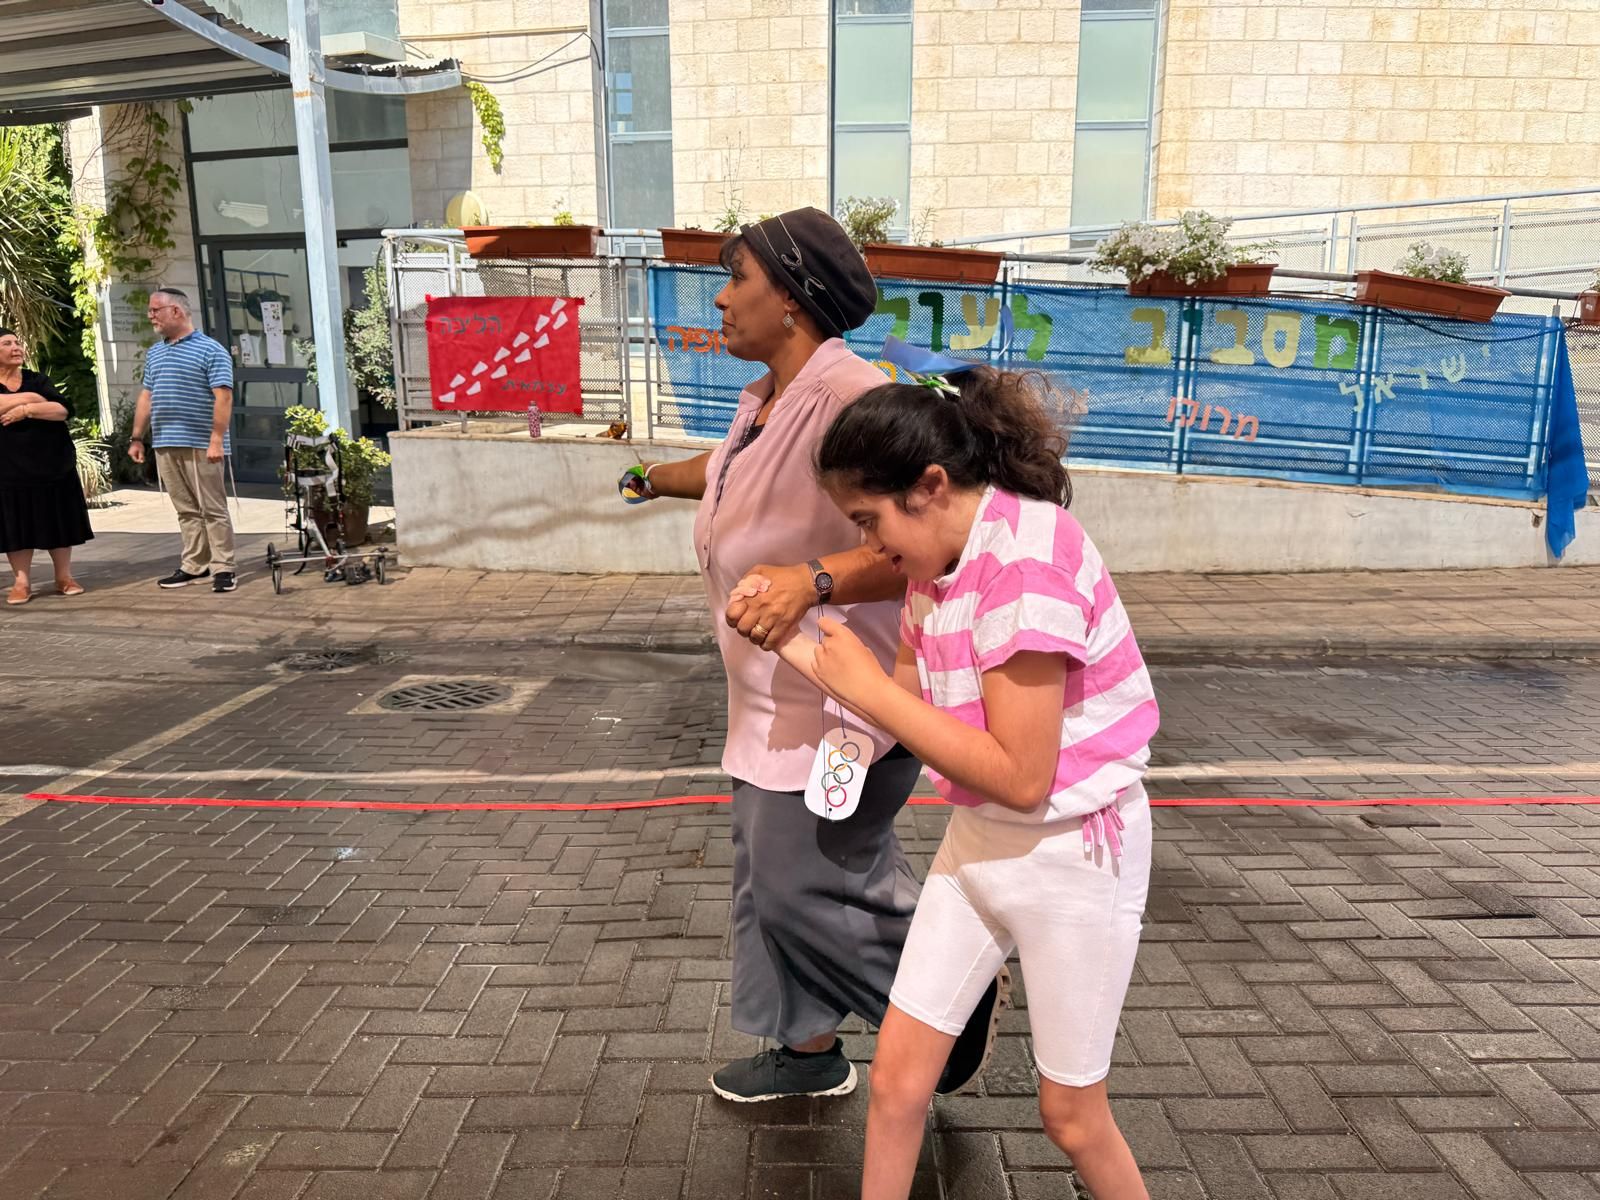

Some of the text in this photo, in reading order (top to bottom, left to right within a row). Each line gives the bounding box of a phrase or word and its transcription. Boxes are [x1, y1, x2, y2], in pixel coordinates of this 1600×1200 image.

[665, 325, 730, 355] ופה
[876, 287, 1360, 369] מסביב לעול
[1339, 344, 1490, 413] ישראל
[1165, 396, 1260, 442] מרוקו
